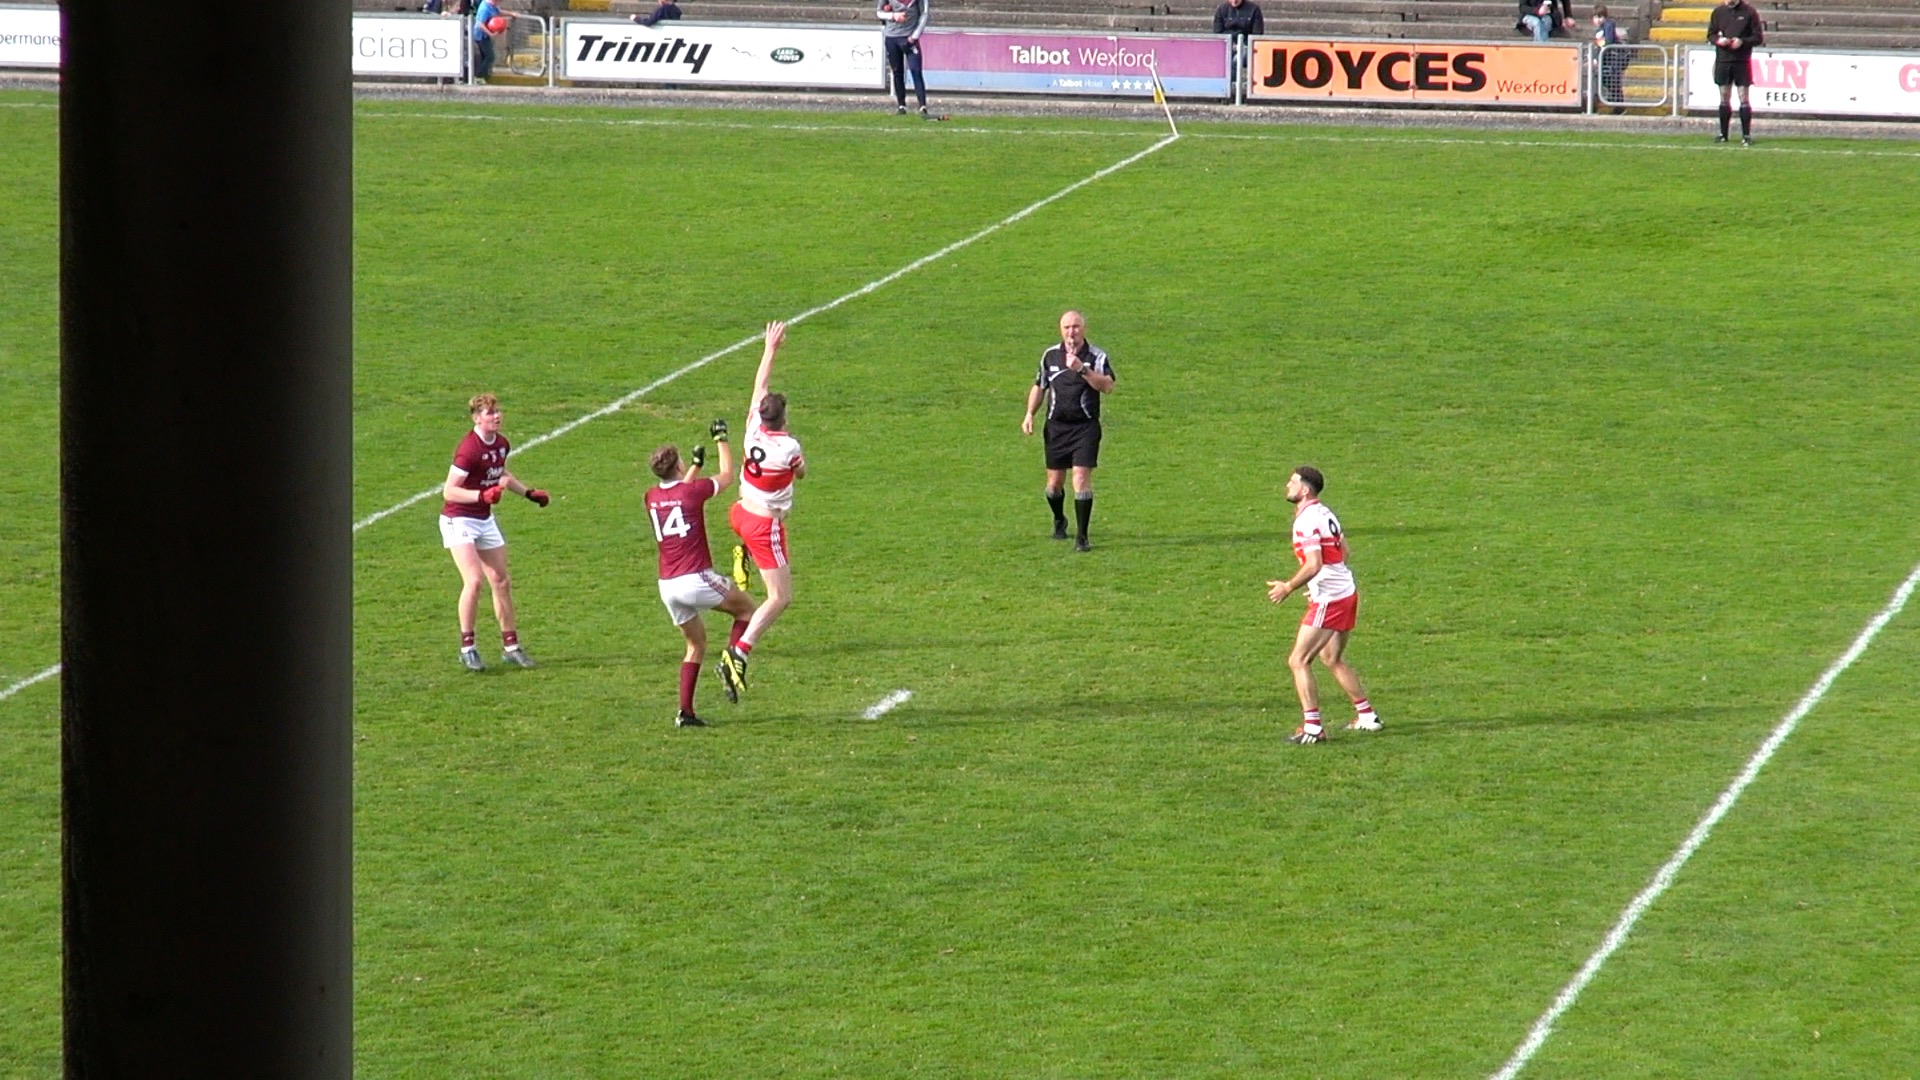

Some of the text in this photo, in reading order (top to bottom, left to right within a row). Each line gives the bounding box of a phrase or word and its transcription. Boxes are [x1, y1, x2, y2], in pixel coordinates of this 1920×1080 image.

[576, 34, 713, 75] Trinity
[1008, 45, 1071, 65] Talbot
[1263, 48, 1487, 92] JOYCES
[1496, 79, 1568, 95] Wexford
[1765, 91, 1807, 103] FEEDS
[746, 445, 767, 479] 8
[649, 505, 692, 542] 14
